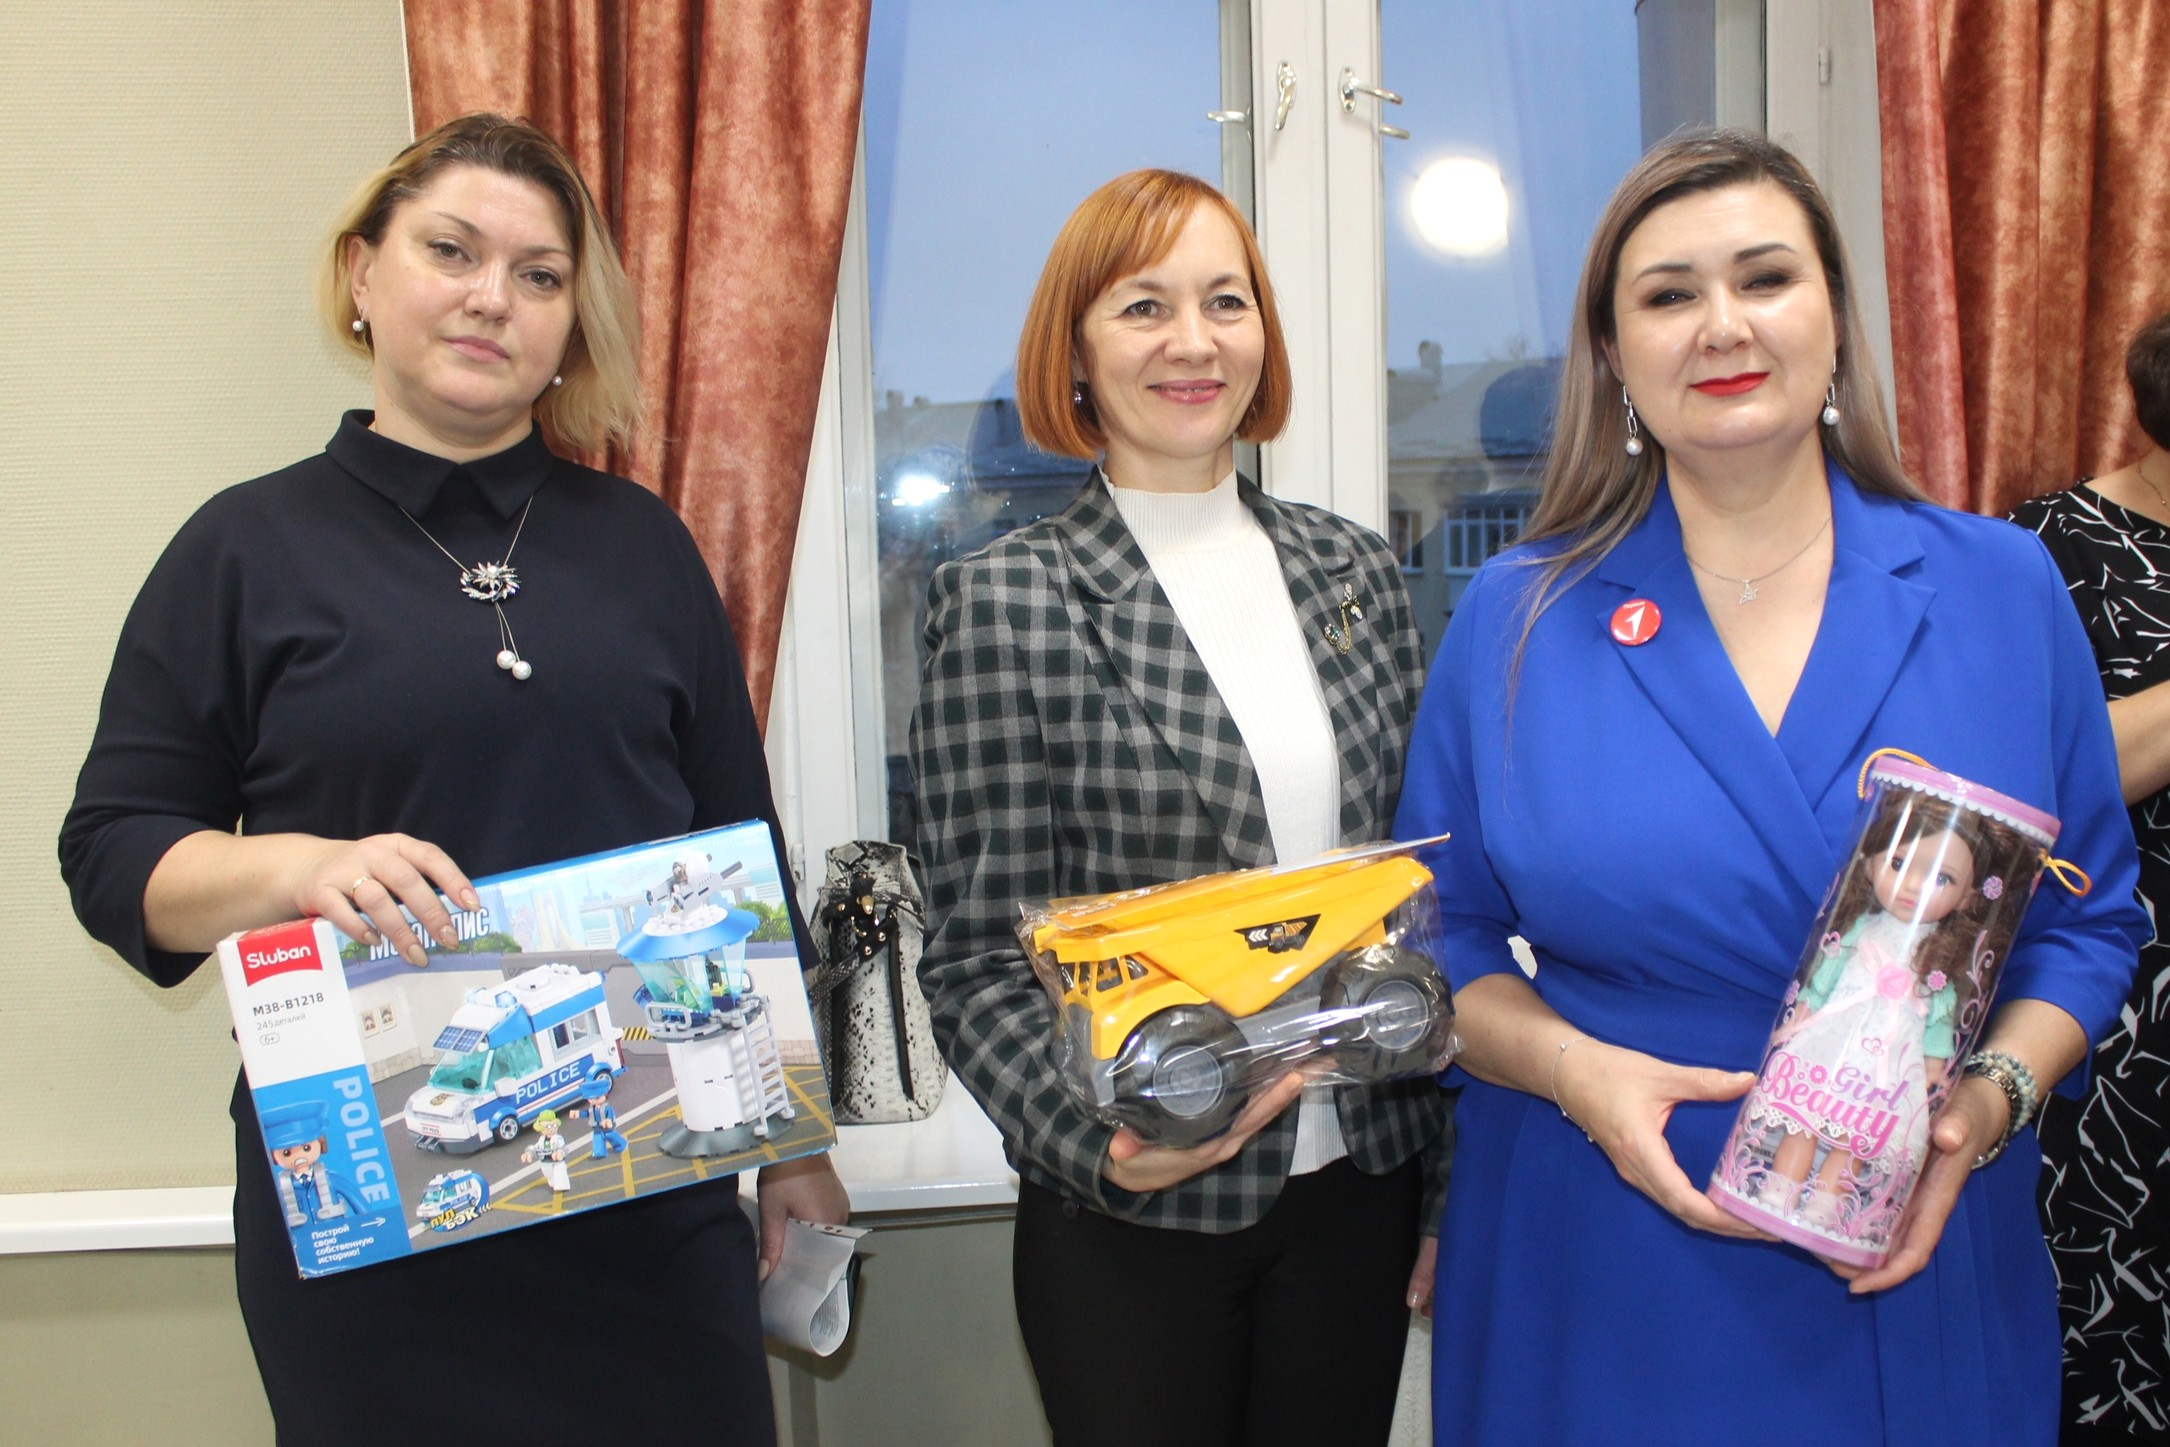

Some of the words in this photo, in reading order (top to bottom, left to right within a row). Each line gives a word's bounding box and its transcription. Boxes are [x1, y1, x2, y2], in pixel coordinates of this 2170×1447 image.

[246, 945, 312, 969] Sluban
[252, 992, 325, 1017] M38-B1218
[257, 1021, 274, 1032] 245
[515, 1060, 582, 1105] POLICE
[1830, 1064, 1910, 1112] Girl
[1760, 1051, 1901, 1160] Beauty
[332, 1074, 391, 1205] POLICE
[430, 1208, 456, 1228] ПУЛ
[446, 1208, 480, 1231] БЭК
[311, 1223, 351, 1240] Построй
[313, 1237, 338, 1249] свою
[315, 1236, 375, 1257] собственную
[317, 1247, 361, 1265] историю!
